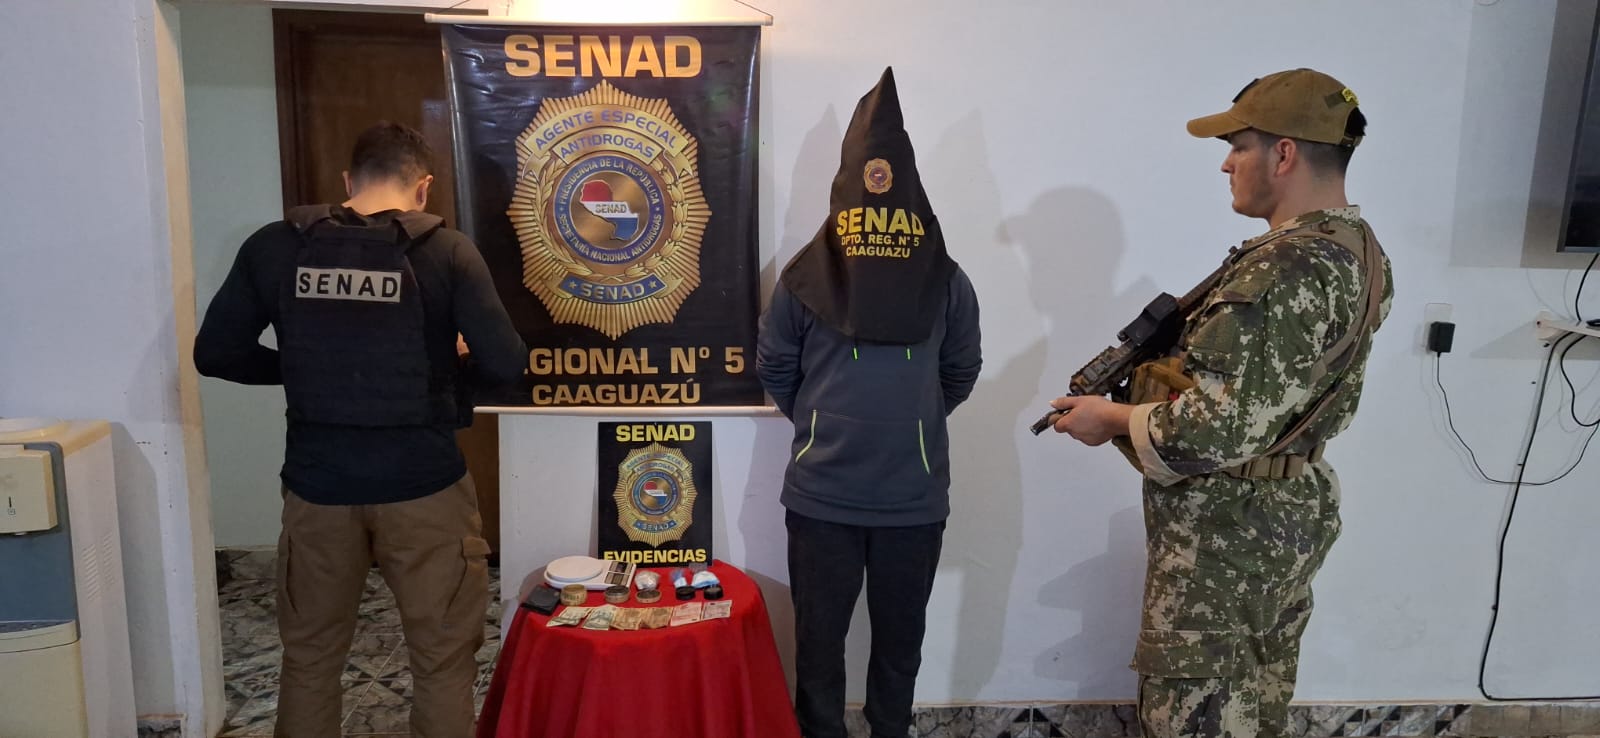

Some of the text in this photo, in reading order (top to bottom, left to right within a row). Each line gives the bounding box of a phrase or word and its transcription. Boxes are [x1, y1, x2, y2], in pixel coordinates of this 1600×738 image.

[504, 35, 702, 77] SENAD
[535, 109, 677, 150] AGENTE ESPECIAL
[560, 134, 655, 159] ANTIDROGAS
[560, 162, 598, 205] PRESIDENCIA
[600, 158, 611, 167] DE
[613, 159, 624, 169] LA
[595, 204, 627, 214] SENAD
[837, 207, 925, 236] SENAD
[591, 250, 631, 262] NACIONAL
[632, 214, 662, 256] ANTIDROGAS
[841, 234, 864, 246] DPTO.
[868, 234, 895, 245] REG.
[914, 237, 920, 247] 5
[846, 246, 911, 258] CAAGUAZU
[299, 272, 398, 298] SENAD
[581, 279, 646, 301] SENAD
[524, 347, 658, 375] GIONAL
[725, 346, 744, 374] 5
[532, 378, 700, 405] CAAGUAZÚ
[616, 424, 695, 442] SENAD
[604, 548, 707, 564] EVIDENCIAS
